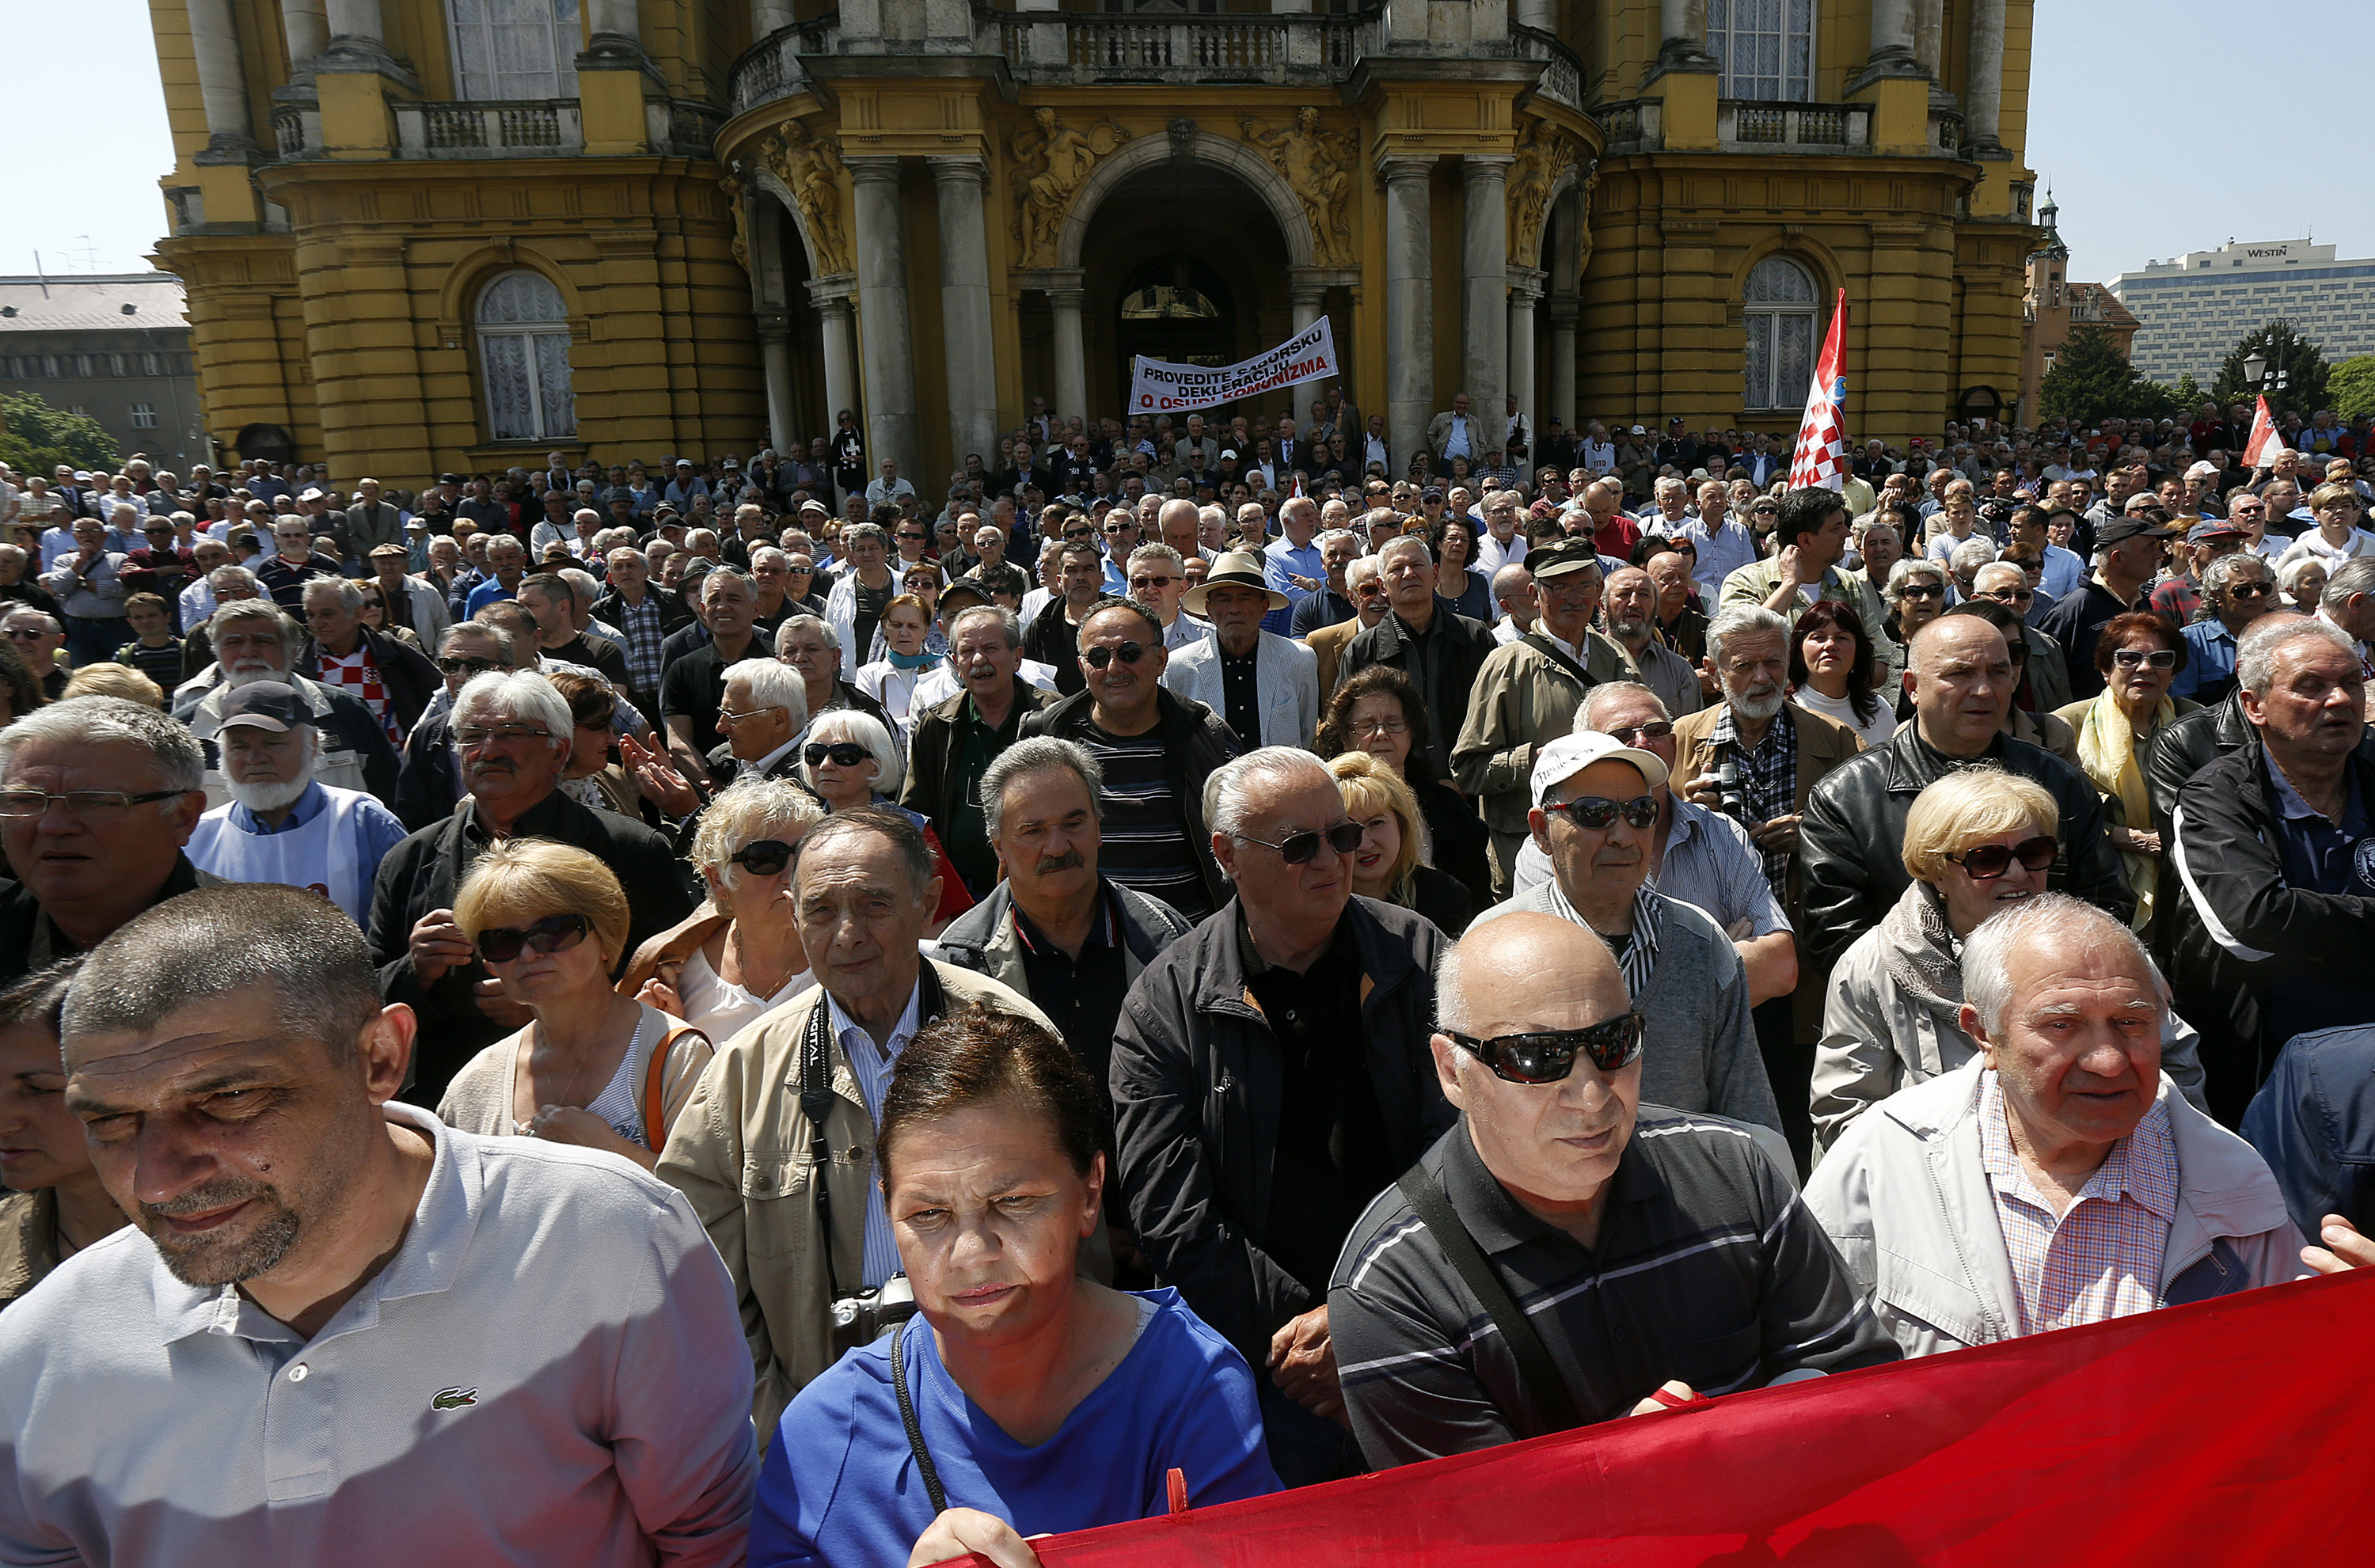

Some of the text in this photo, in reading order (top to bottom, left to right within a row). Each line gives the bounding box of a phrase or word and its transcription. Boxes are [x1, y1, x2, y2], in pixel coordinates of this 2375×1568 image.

[2248, 249, 2287, 257] WESTIN
[1143, 366, 1232, 385] PROVEDITE
[1178, 360, 1290, 398] DEKLERACIJU
[1141, 393, 1154, 408] O
[809, 1007, 820, 1067] DIGITAL
